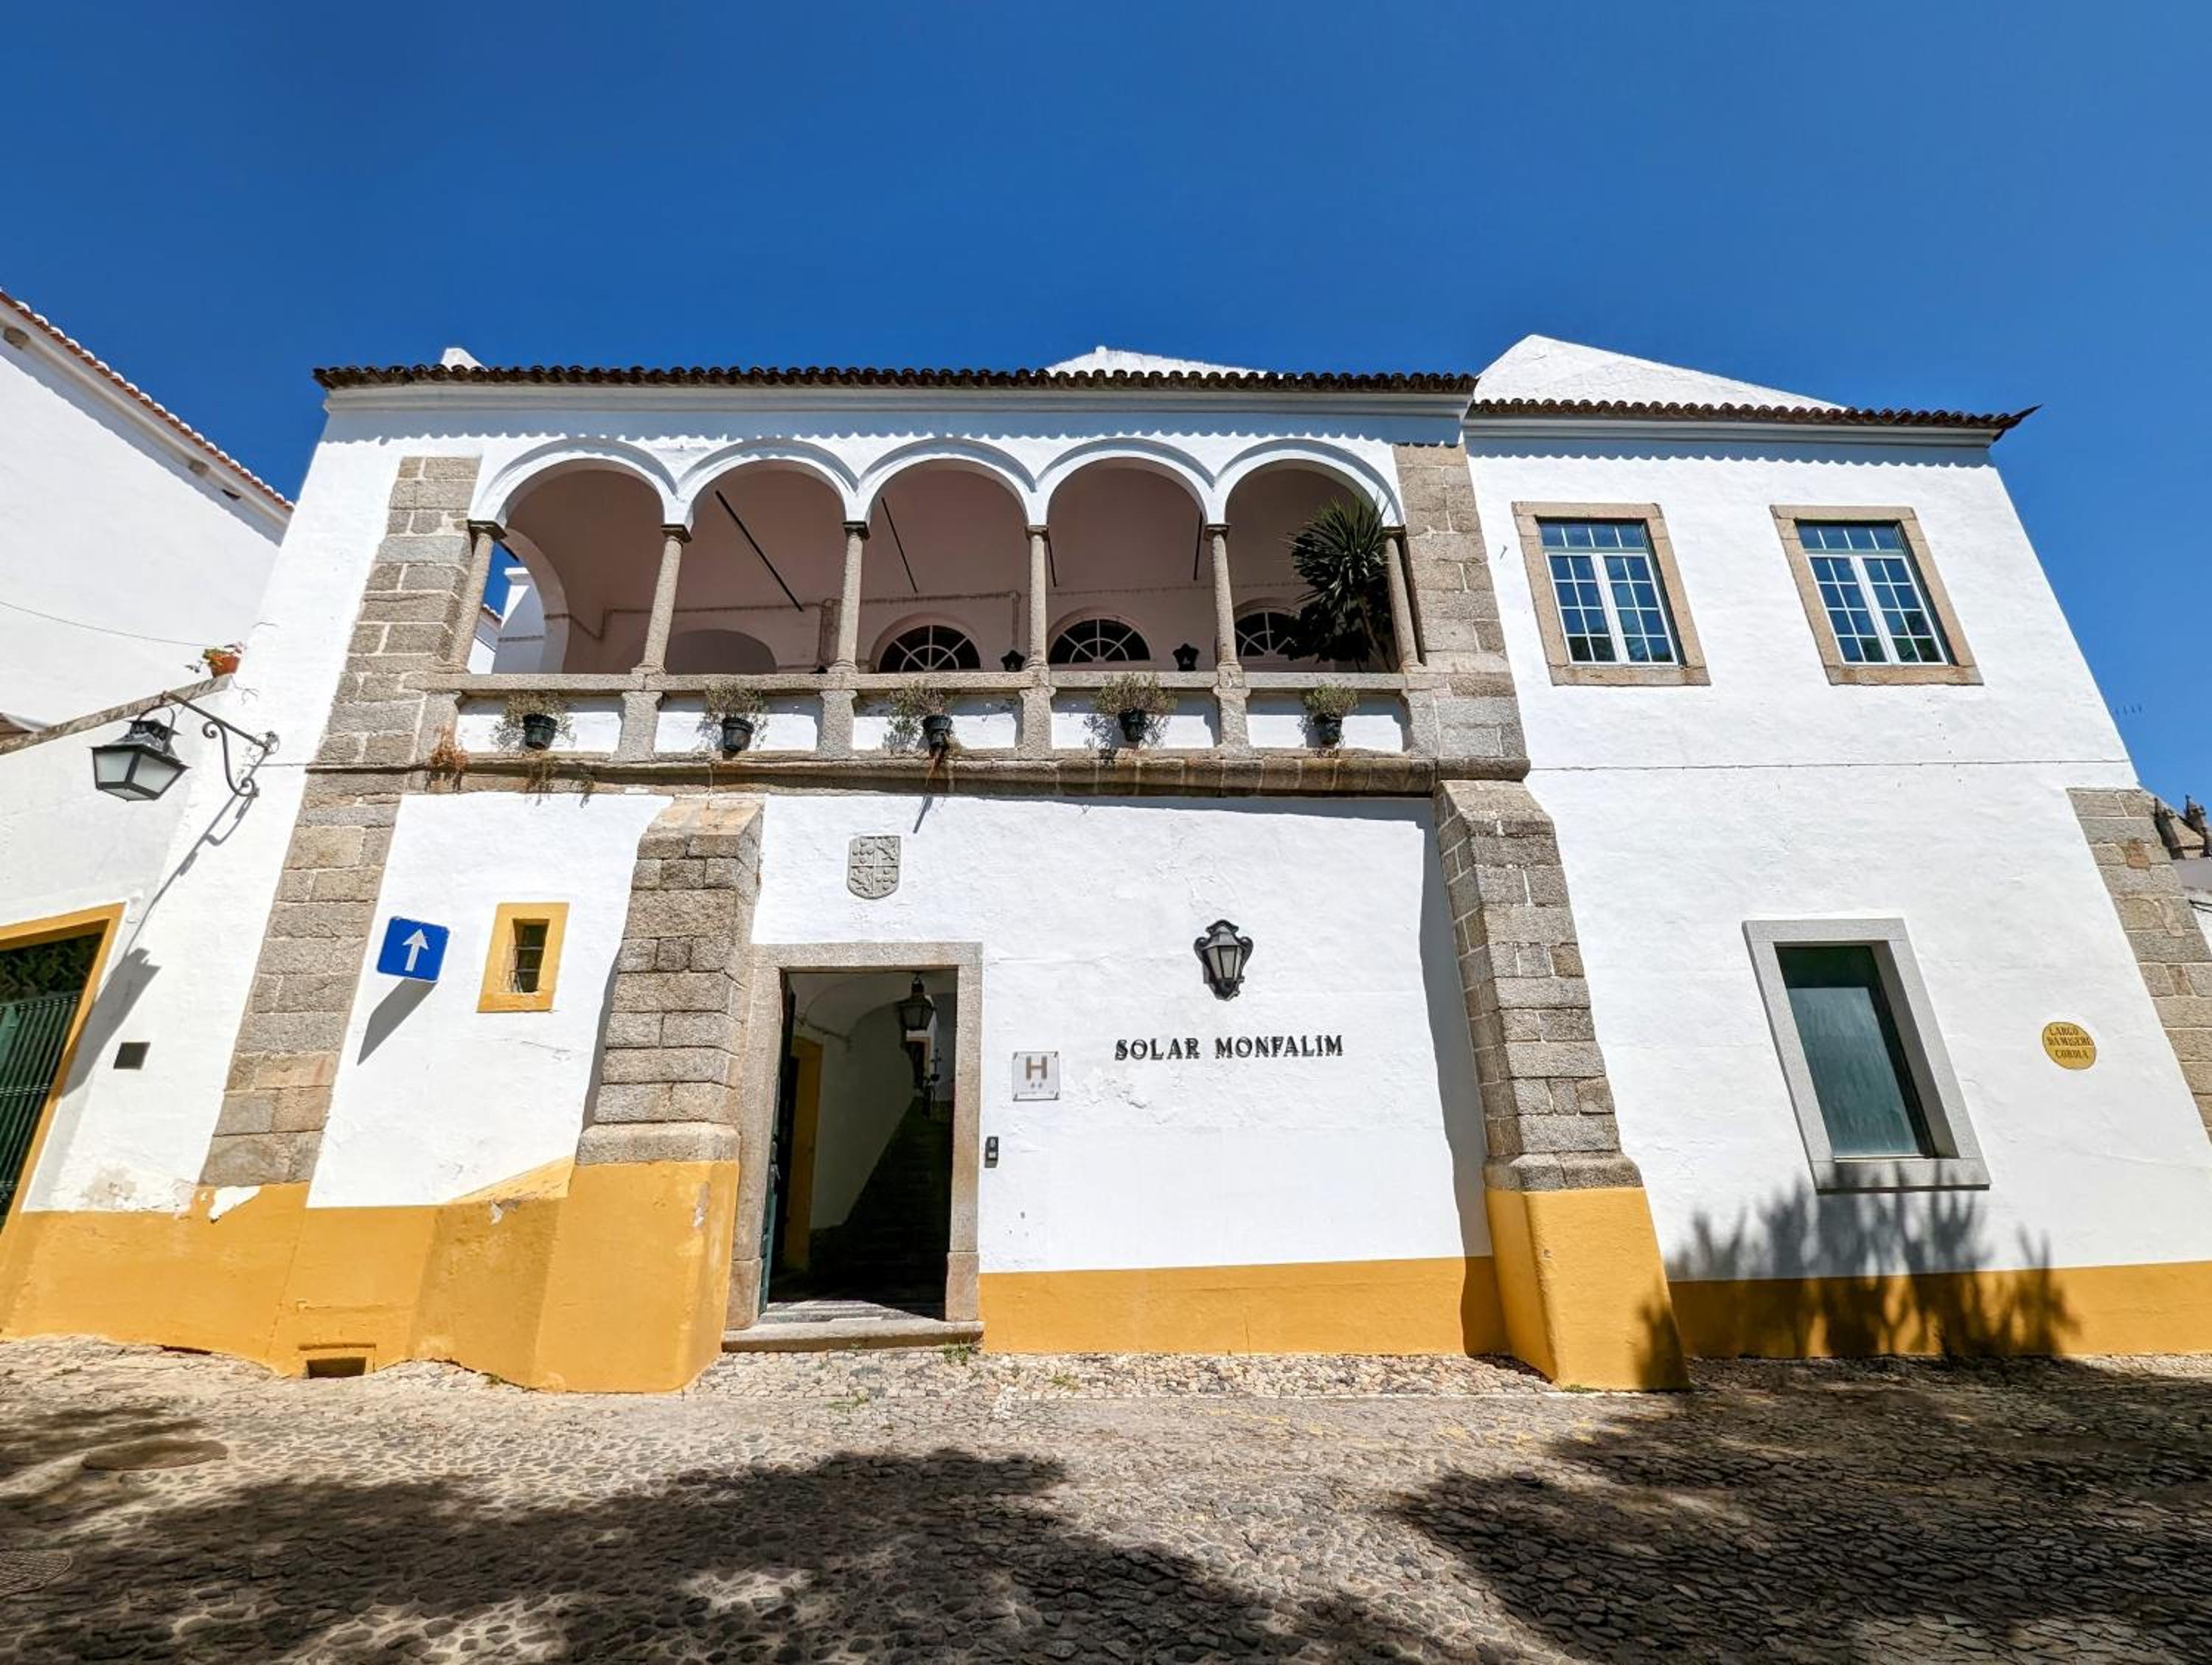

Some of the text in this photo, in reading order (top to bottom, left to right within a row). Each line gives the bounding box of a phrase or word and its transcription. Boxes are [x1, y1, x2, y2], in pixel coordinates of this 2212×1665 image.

[1115, 1035, 1343, 1060] SOLAR MONFALIM
[1026, 1055, 1048, 1080] H
